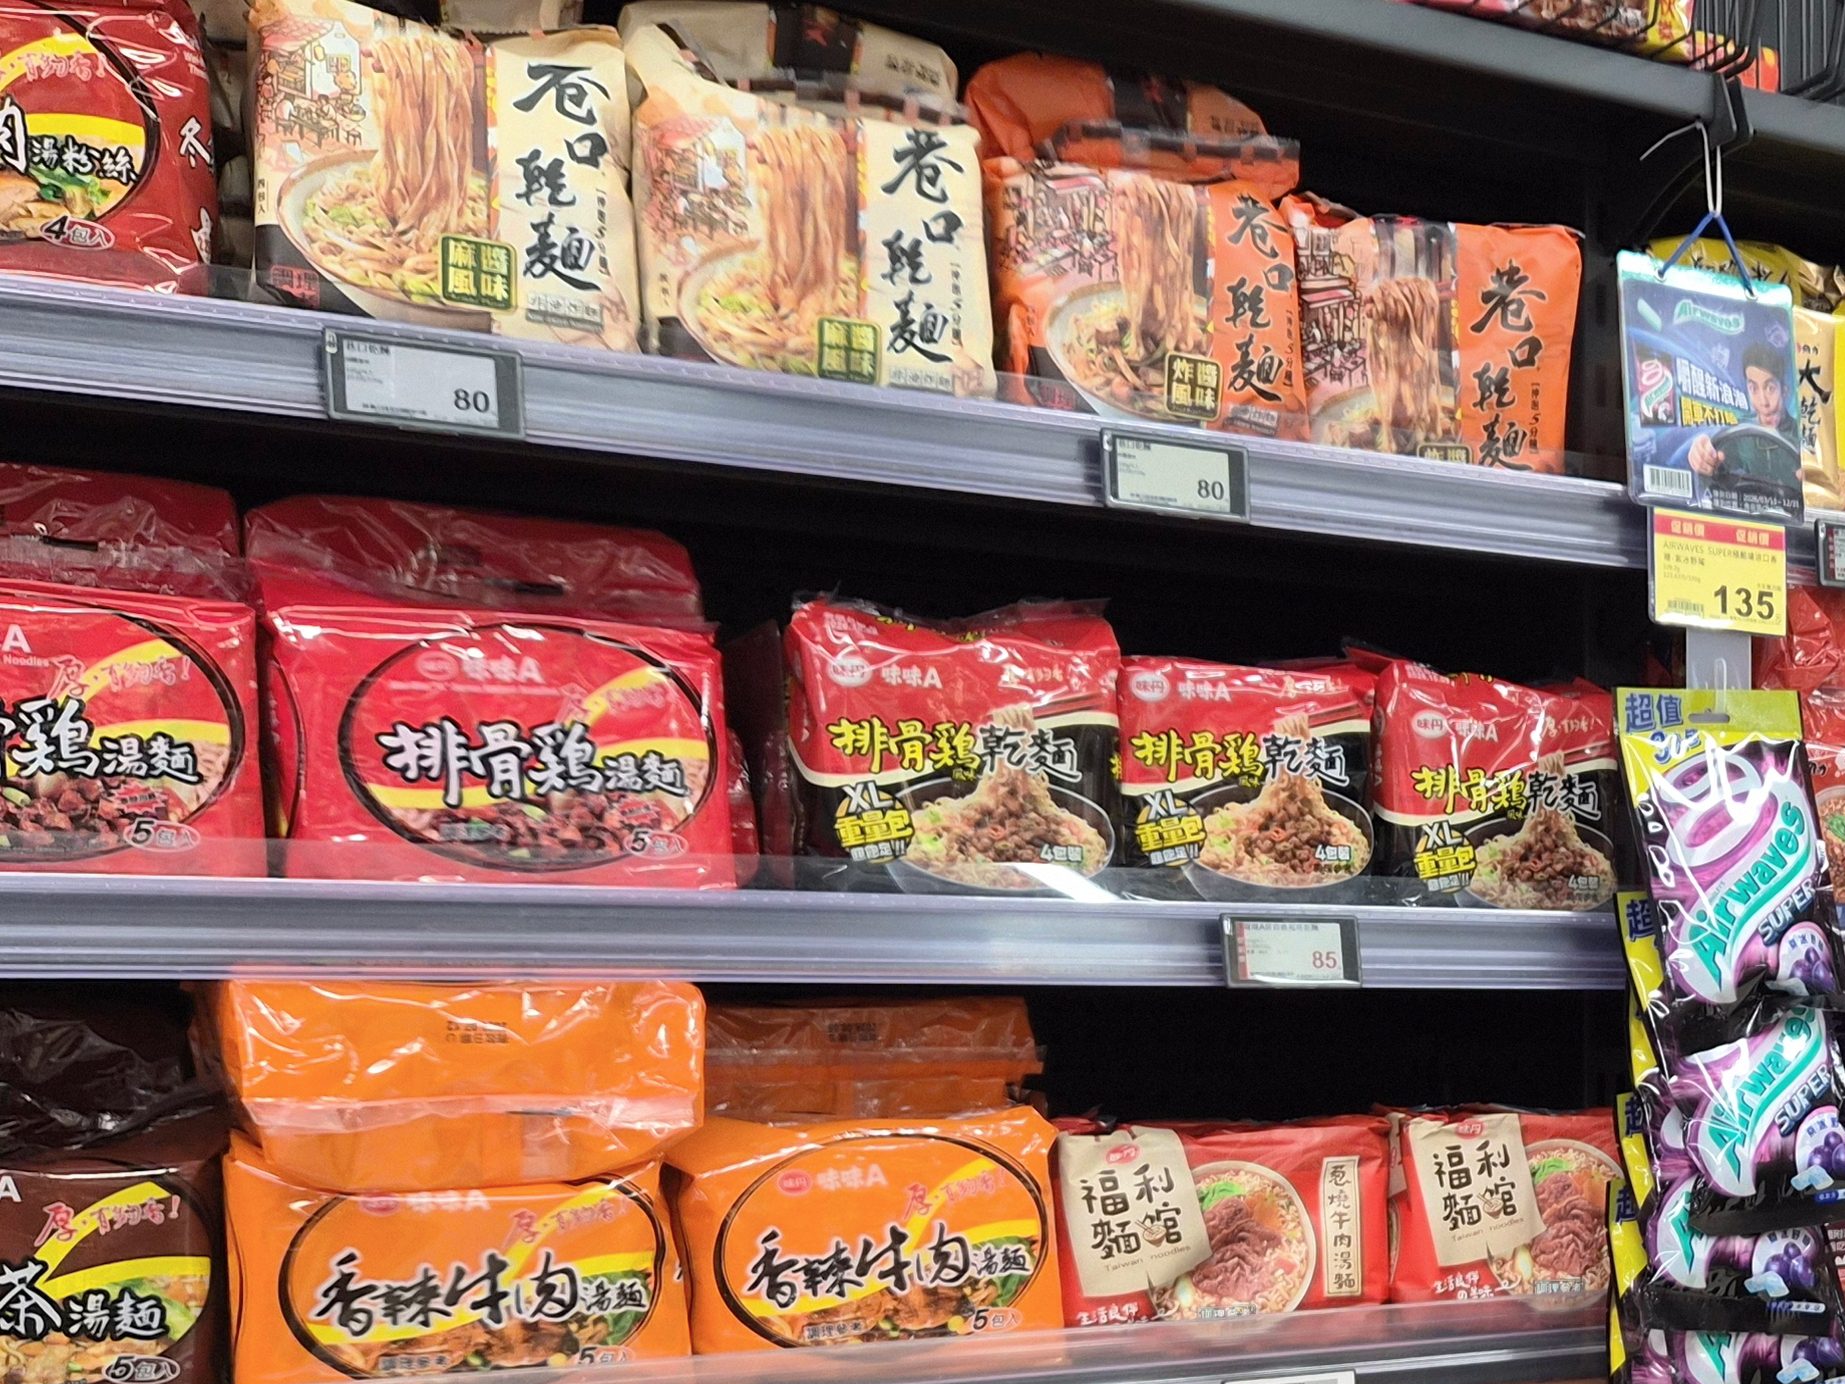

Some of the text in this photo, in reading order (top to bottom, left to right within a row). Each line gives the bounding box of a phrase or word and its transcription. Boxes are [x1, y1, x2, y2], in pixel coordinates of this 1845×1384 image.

[1674, 299, 1745, 336] Airwaves
[453, 388, 490, 413] 80
[1196, 479, 1225, 501] 80
[1663, 541, 1705, 556] AIRWAVES
[1736, 528, 1770, 547] 促銷價
[1714, 584, 1775, 621] 135
[1625, 692, 1682, 734] 超值
[843, 781, 893, 812] XL
[1146, 790, 1187, 821] XL
[835, 811, 914, 845] 重量包
[1134, 816, 1207, 850] 重量包
[1422, 822, 1463, 850] XL
[1414, 844, 1477, 881] 重量包
[1689, 800, 1805, 991] Airwaves
[1757, 879, 1816, 945] SUPER
[1312, 950, 1337, 969] 85
[1775, 1065, 1832, 1136] SUPER
[1432, 1139, 1511, 1190] 福利
[1081, 1163, 1175, 1216] 福利
[747, 1223, 1030, 1309] 香辣牛肉湯麵
[1104, 1244, 1191, 1272] Taiwan noodles
[315, 1251, 648, 1337] 香辣牛肉湯麵
[972, 1308, 1018, 1331] 5包入
